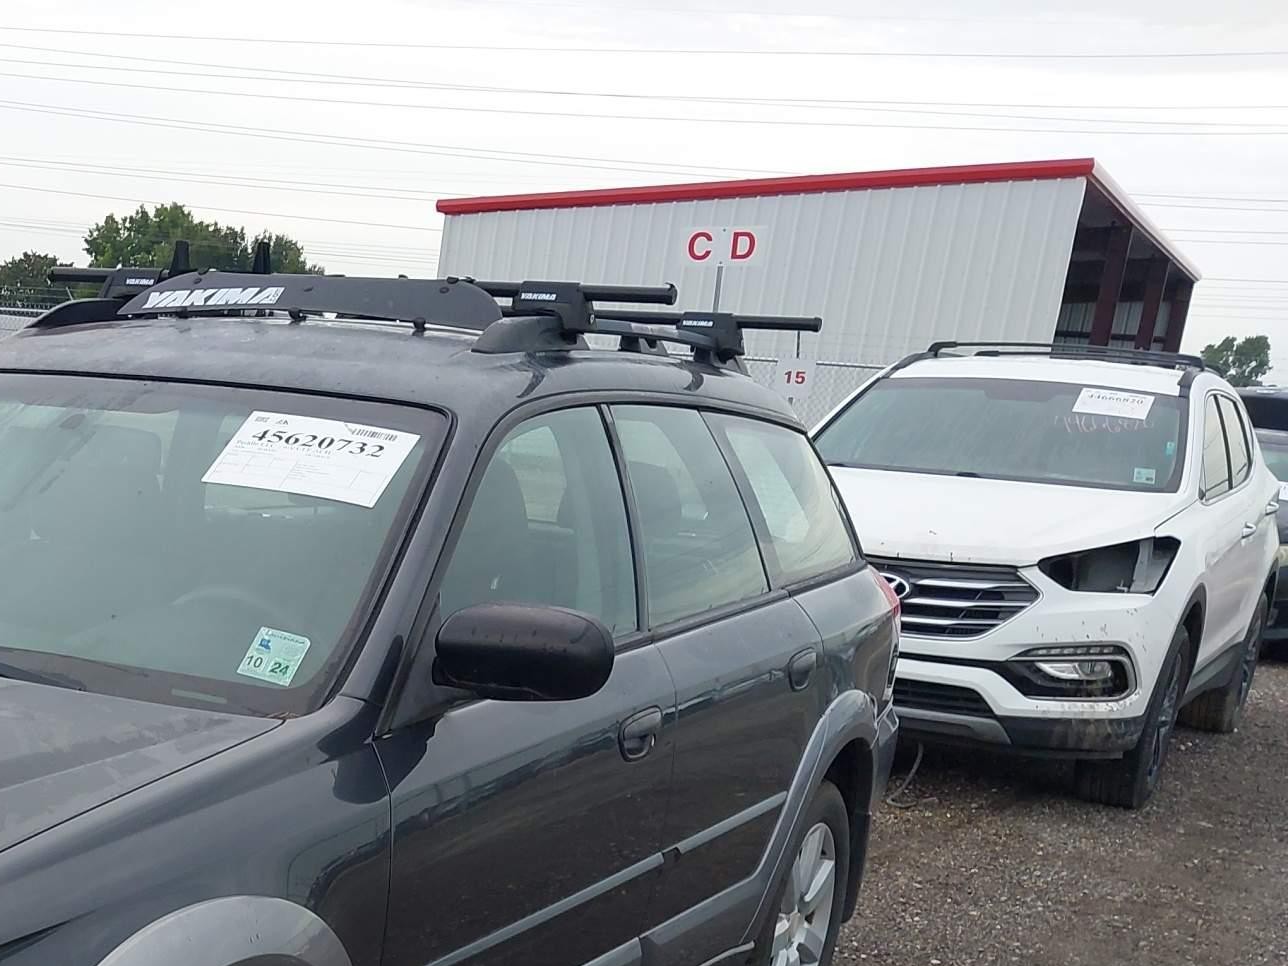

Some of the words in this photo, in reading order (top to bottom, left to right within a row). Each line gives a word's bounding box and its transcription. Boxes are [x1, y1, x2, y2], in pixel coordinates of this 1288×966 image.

[688, 231, 713, 261] C
[730, 231, 756, 260] D
[126, 278, 155, 286] YAKIMA
[142, 287, 285, 309] YAKIMA
[521, 292, 557, 301] YAKIMA
[682, 319, 714, 327] YAKIMA
[784, 371, 806, 385] 15
[252, 429, 385, 458] 45620732
[246, 655, 264, 669] 10
[269, 662, 290, 676] 24
